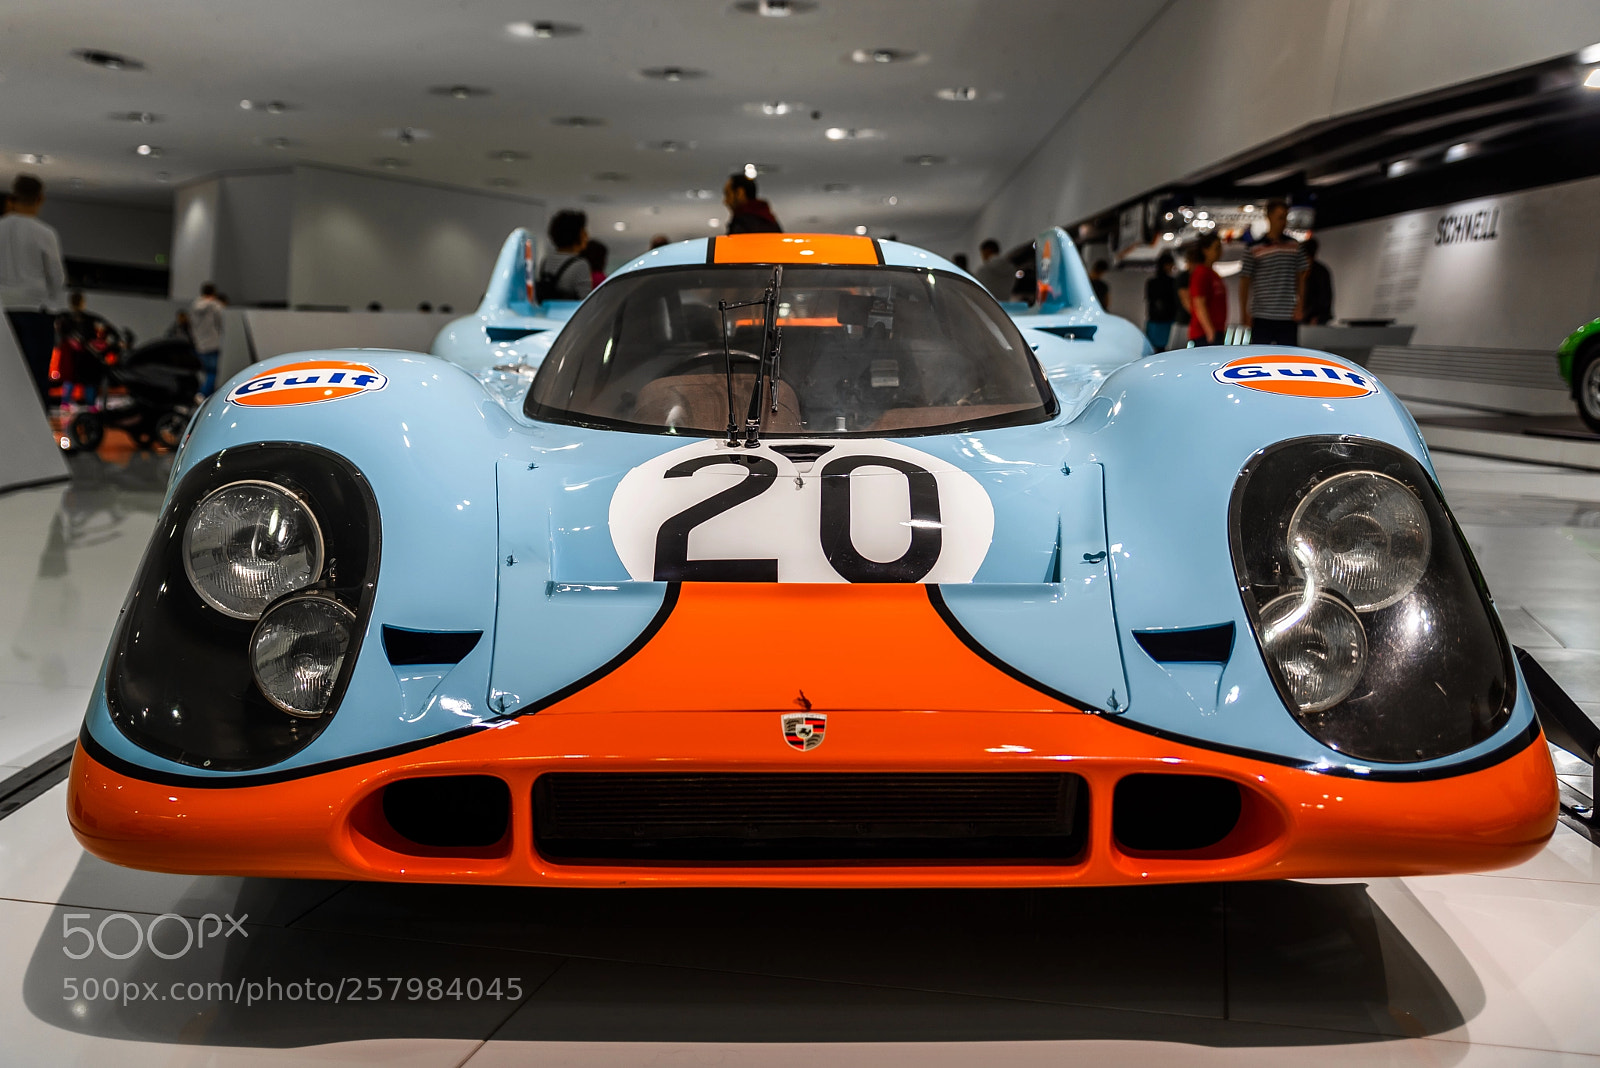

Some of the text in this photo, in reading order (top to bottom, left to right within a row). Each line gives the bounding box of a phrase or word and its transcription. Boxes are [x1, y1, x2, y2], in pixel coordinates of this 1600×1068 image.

[1434, 207, 1500, 246] SCHNELL
[235, 372, 379, 395] Gulf
[1223, 366, 1367, 387] Gulf
[653, 454, 943, 583] 20
